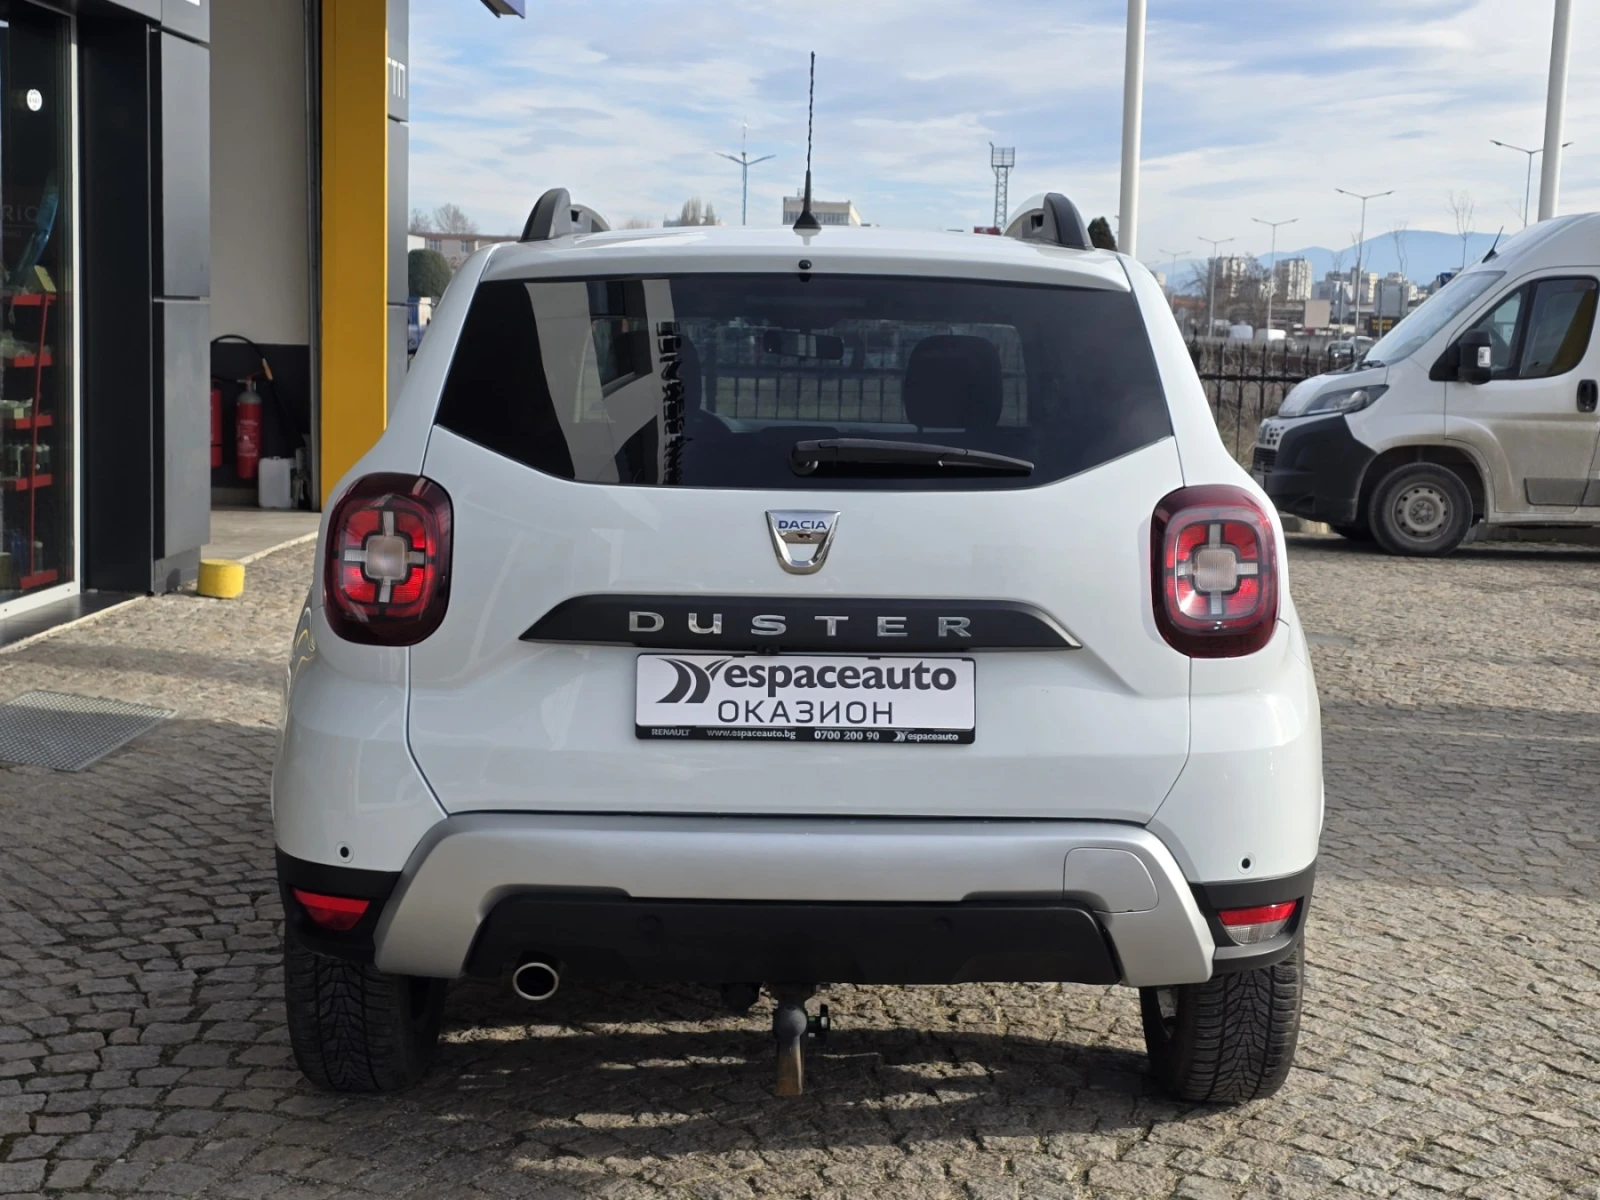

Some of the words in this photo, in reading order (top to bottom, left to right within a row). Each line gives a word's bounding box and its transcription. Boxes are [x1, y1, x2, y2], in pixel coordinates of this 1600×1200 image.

[778, 520, 827, 529] DACIA
[628, 611, 972, 638] DUSTER
[723, 660, 957, 698] espaceauto
[717, 699, 893, 725] ОКАЗИОН
[651, 728, 691, 737] RENAULT
[706, 728, 796, 740] www.espaceauto.bg
[814, 730, 841, 740] 0700
[843, 731, 863, 740] 200
[866, 731, 880, 741] 90
[907, 732, 959, 742] espaceauto
